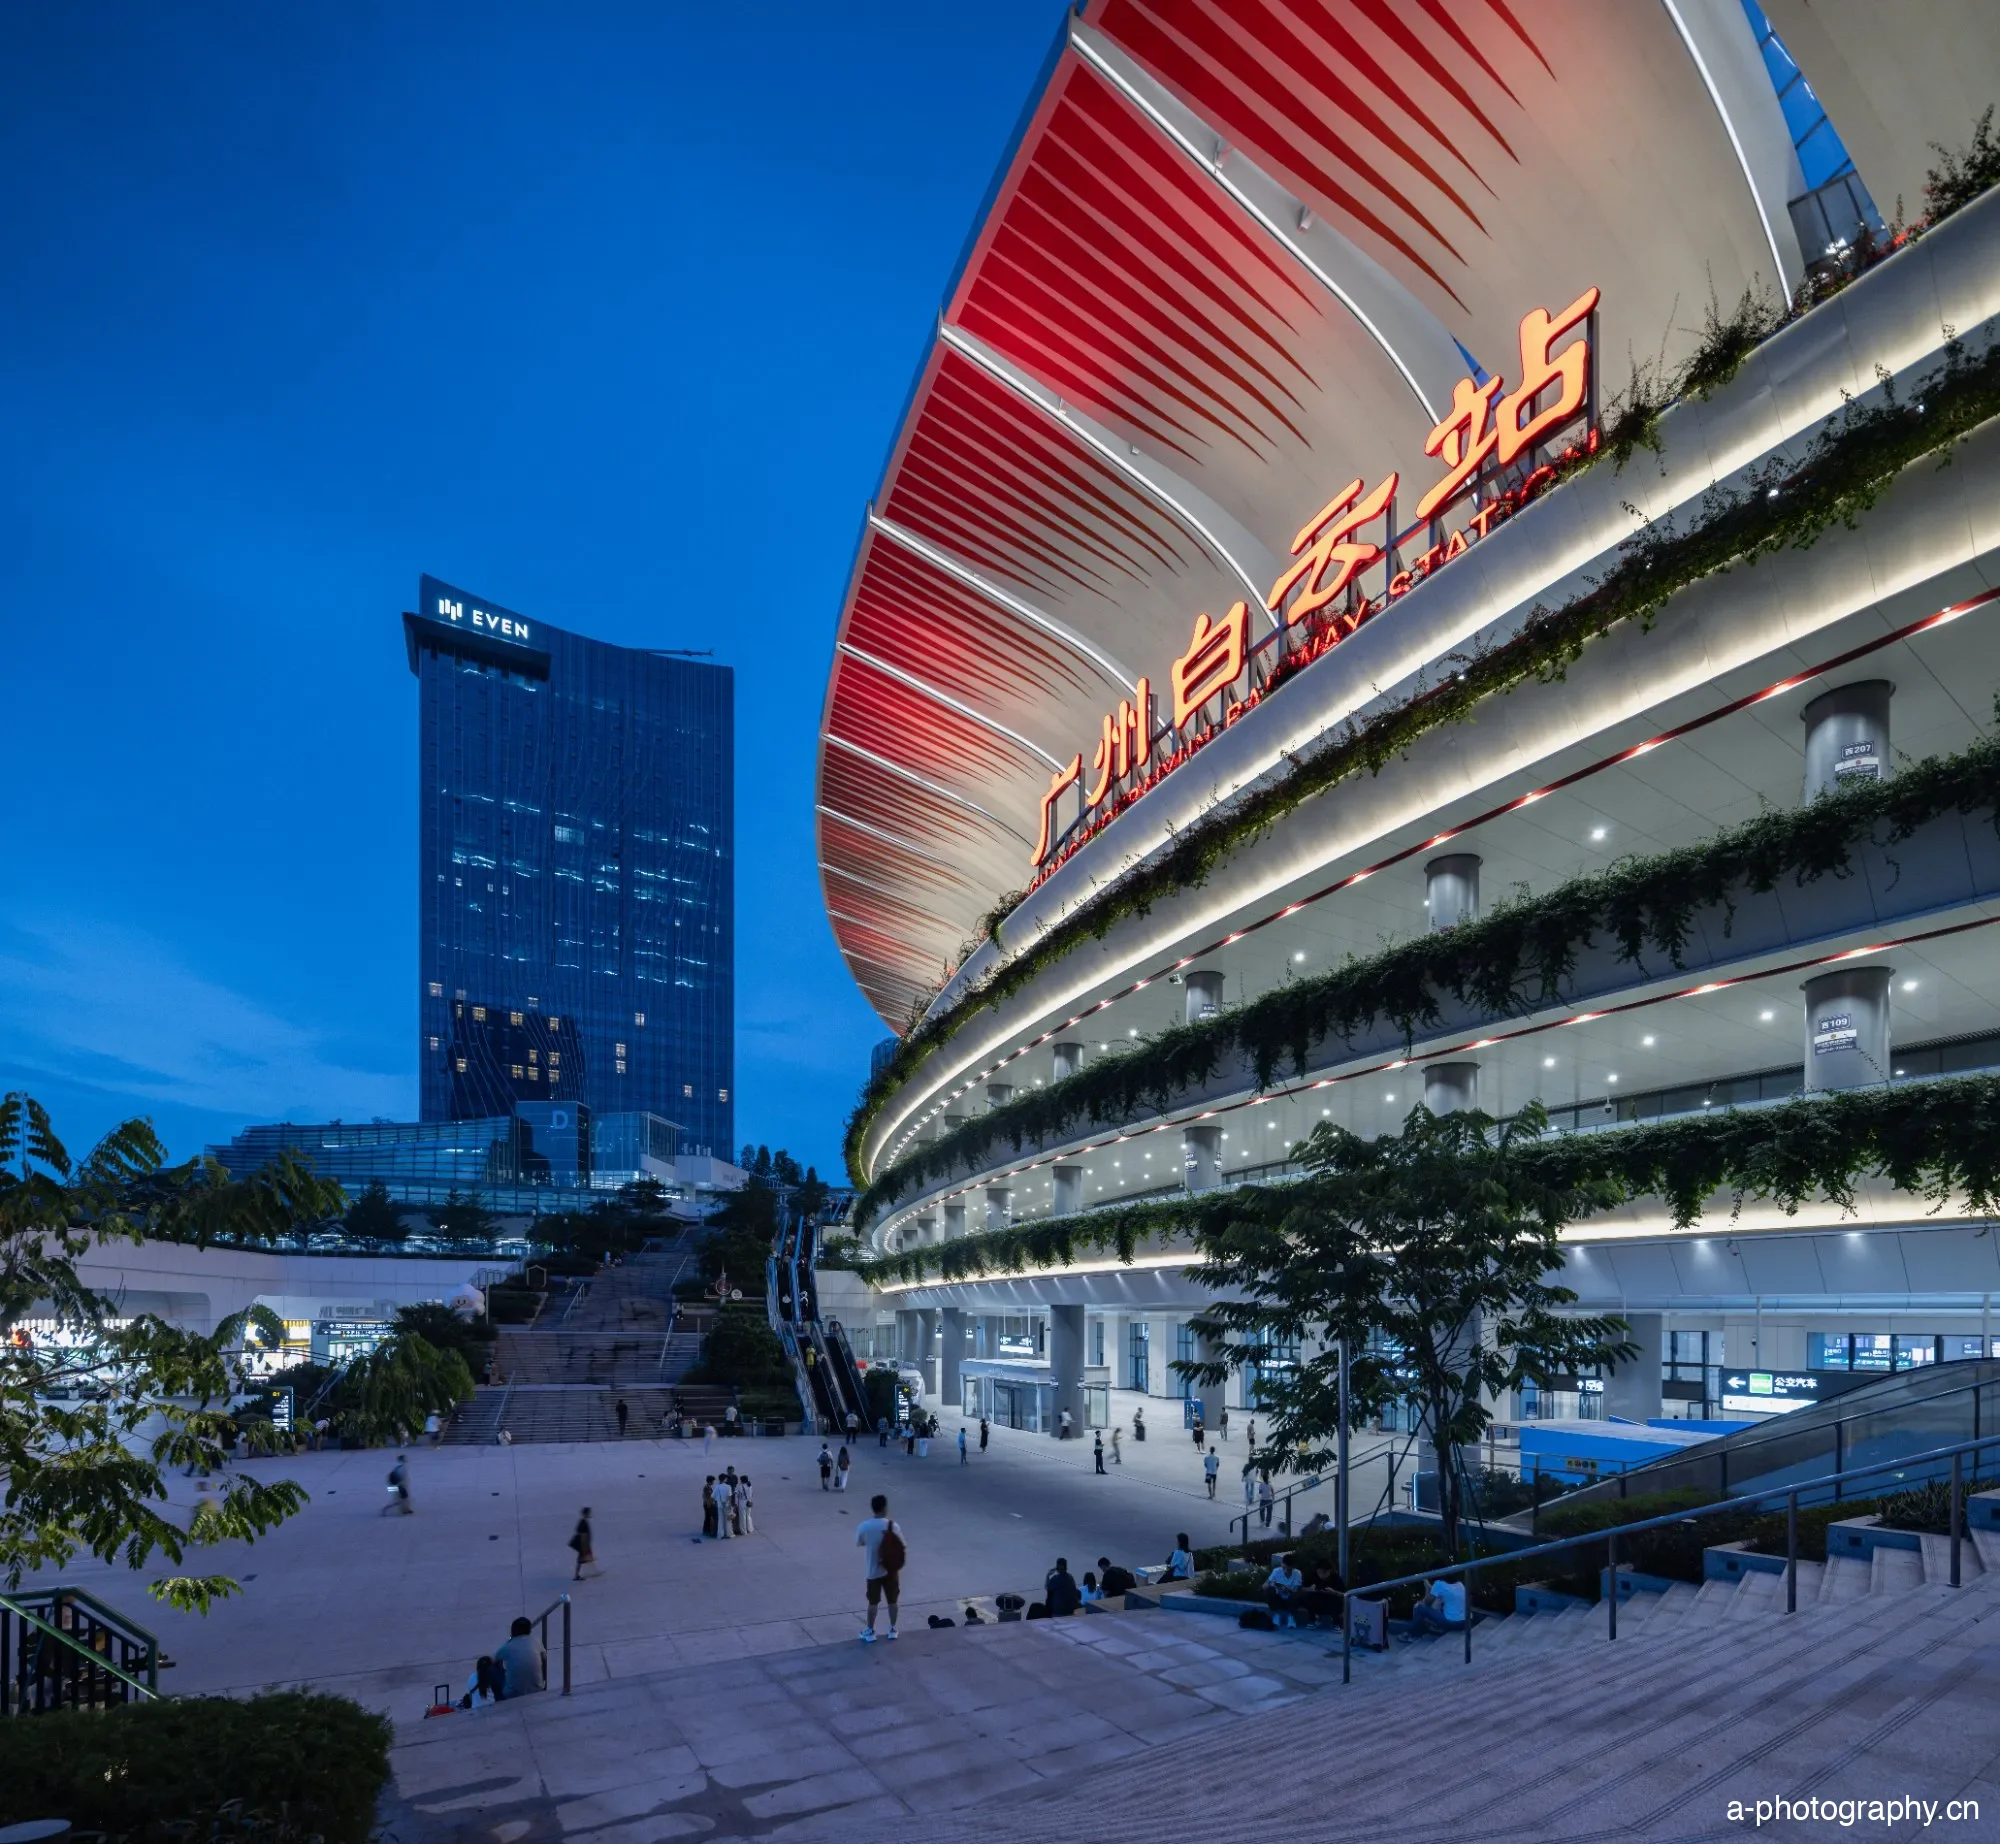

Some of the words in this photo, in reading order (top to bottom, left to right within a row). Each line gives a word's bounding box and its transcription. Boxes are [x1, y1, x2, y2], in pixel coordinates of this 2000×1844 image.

[1030, 285, 1601, 868] 广州白云站
[472, 609, 528, 639] EVEN
[1226, 599, 1367, 728] RAIWAY
[552, 1110, 569, 1130] D
[1773, 1386, 1788, 1394] Bus
[1774, 1376, 1818, 1389] 公交汽车
